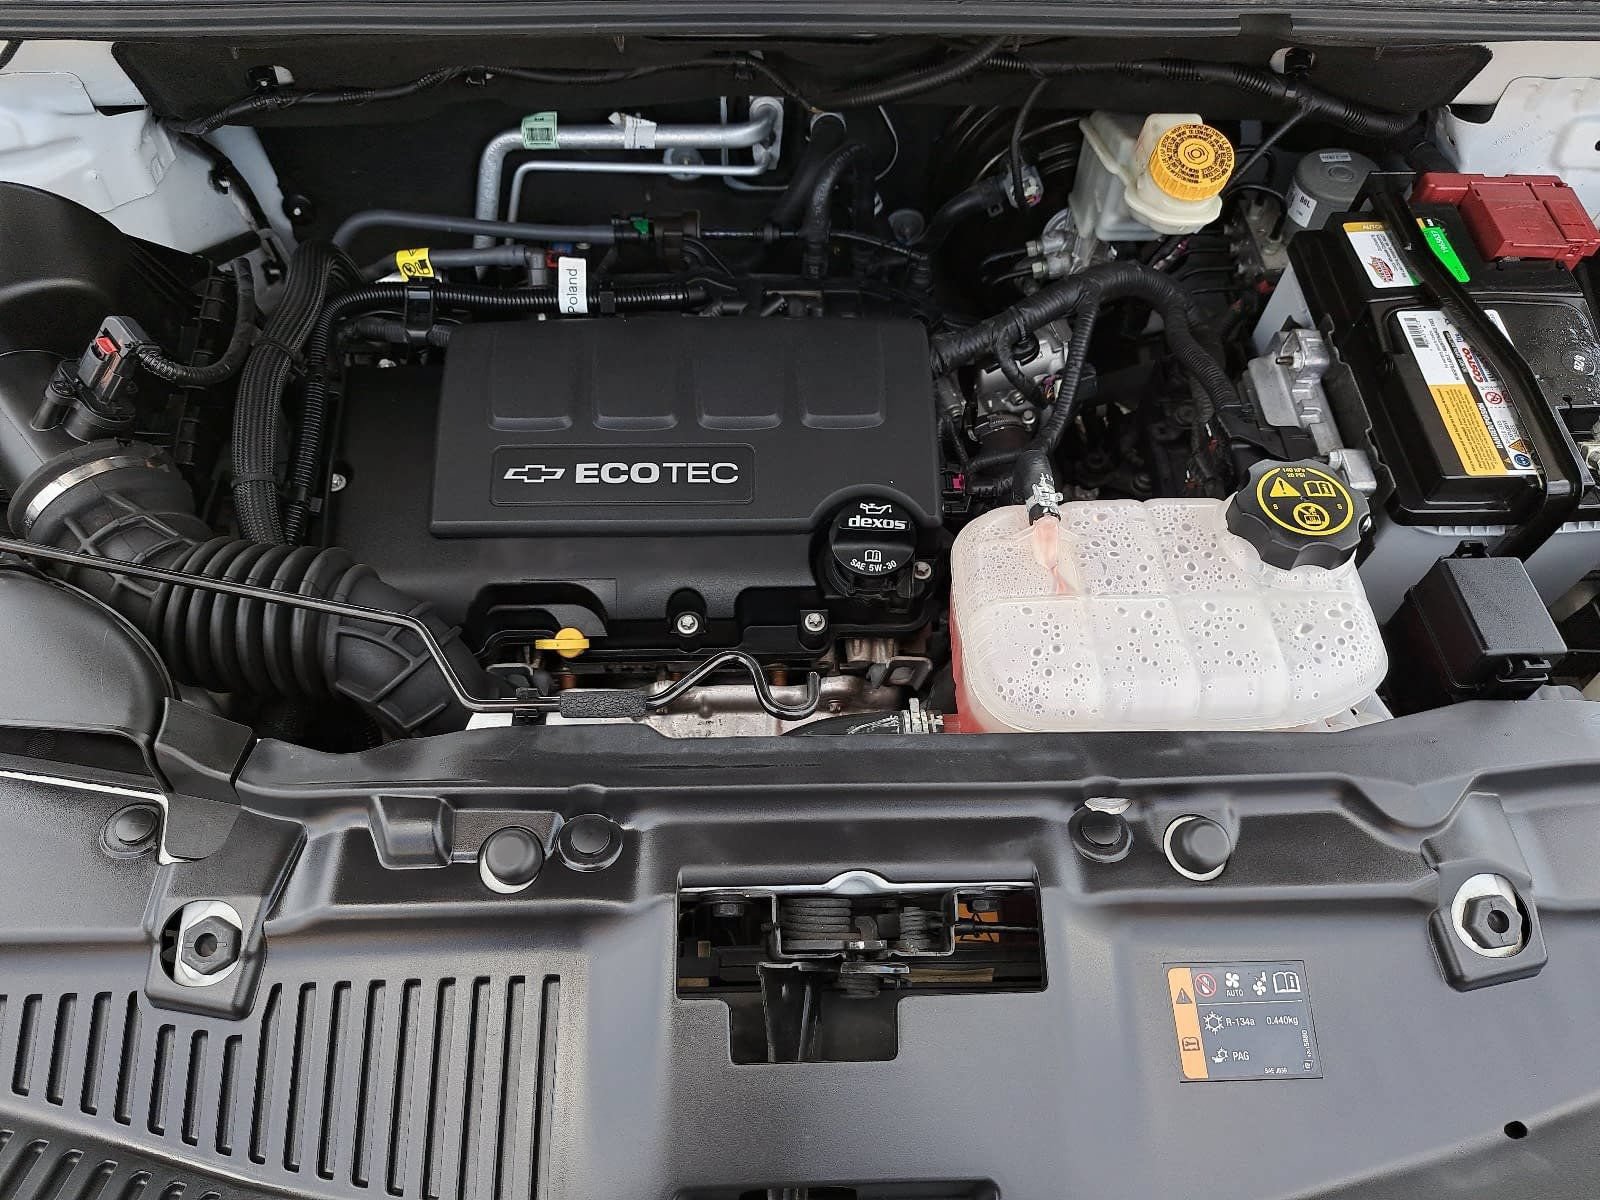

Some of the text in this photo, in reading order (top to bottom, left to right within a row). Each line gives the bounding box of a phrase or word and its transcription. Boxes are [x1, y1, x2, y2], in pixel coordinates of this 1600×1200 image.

[566, 268, 578, 313] Poland
[575, 462, 739, 484] ECOTEC
[848, 515, 907, 530] dexos
[850, 558, 897, 572] SAE 5W-30
[1226, 989, 1244, 997] AUTO
[1226, 1017, 1256, 1027] R-134a
[1266, 1016, 1299, 1026] 0.440kg
[1232, 1051, 1250, 1061] PAG
